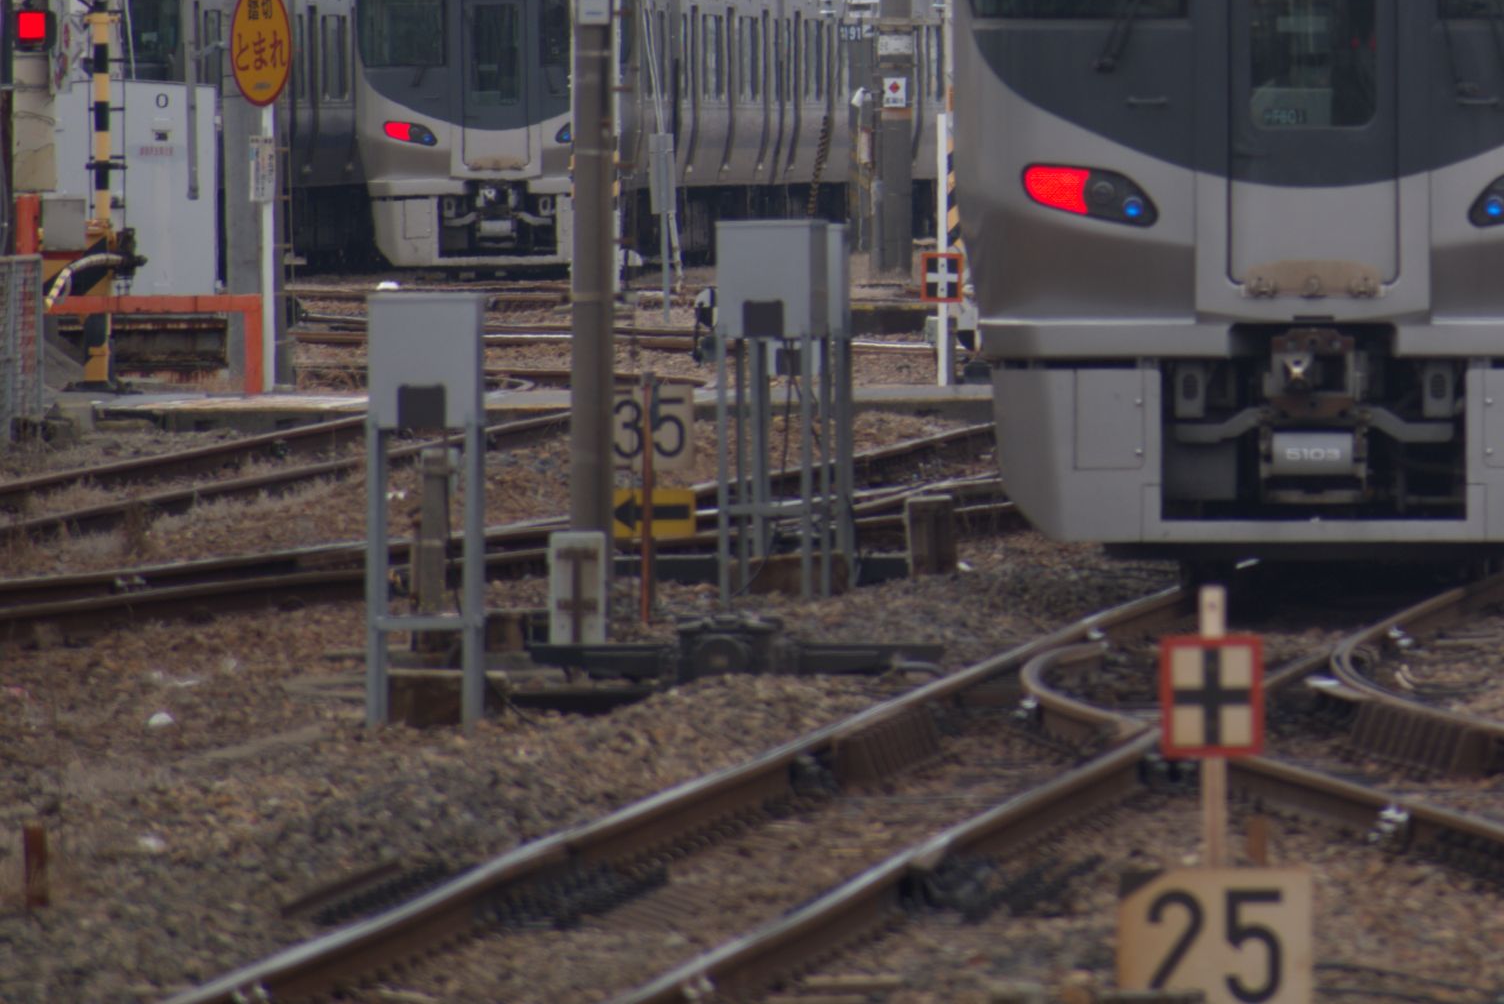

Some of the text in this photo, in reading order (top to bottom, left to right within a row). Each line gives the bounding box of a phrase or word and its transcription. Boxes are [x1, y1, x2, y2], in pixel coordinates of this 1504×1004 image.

[235, 29, 287, 71] とまれ
[612, 398, 685, 459] 35
[1286, 447, 1341, 461] 5103
[1147, 886, 1282, 1004] 25
